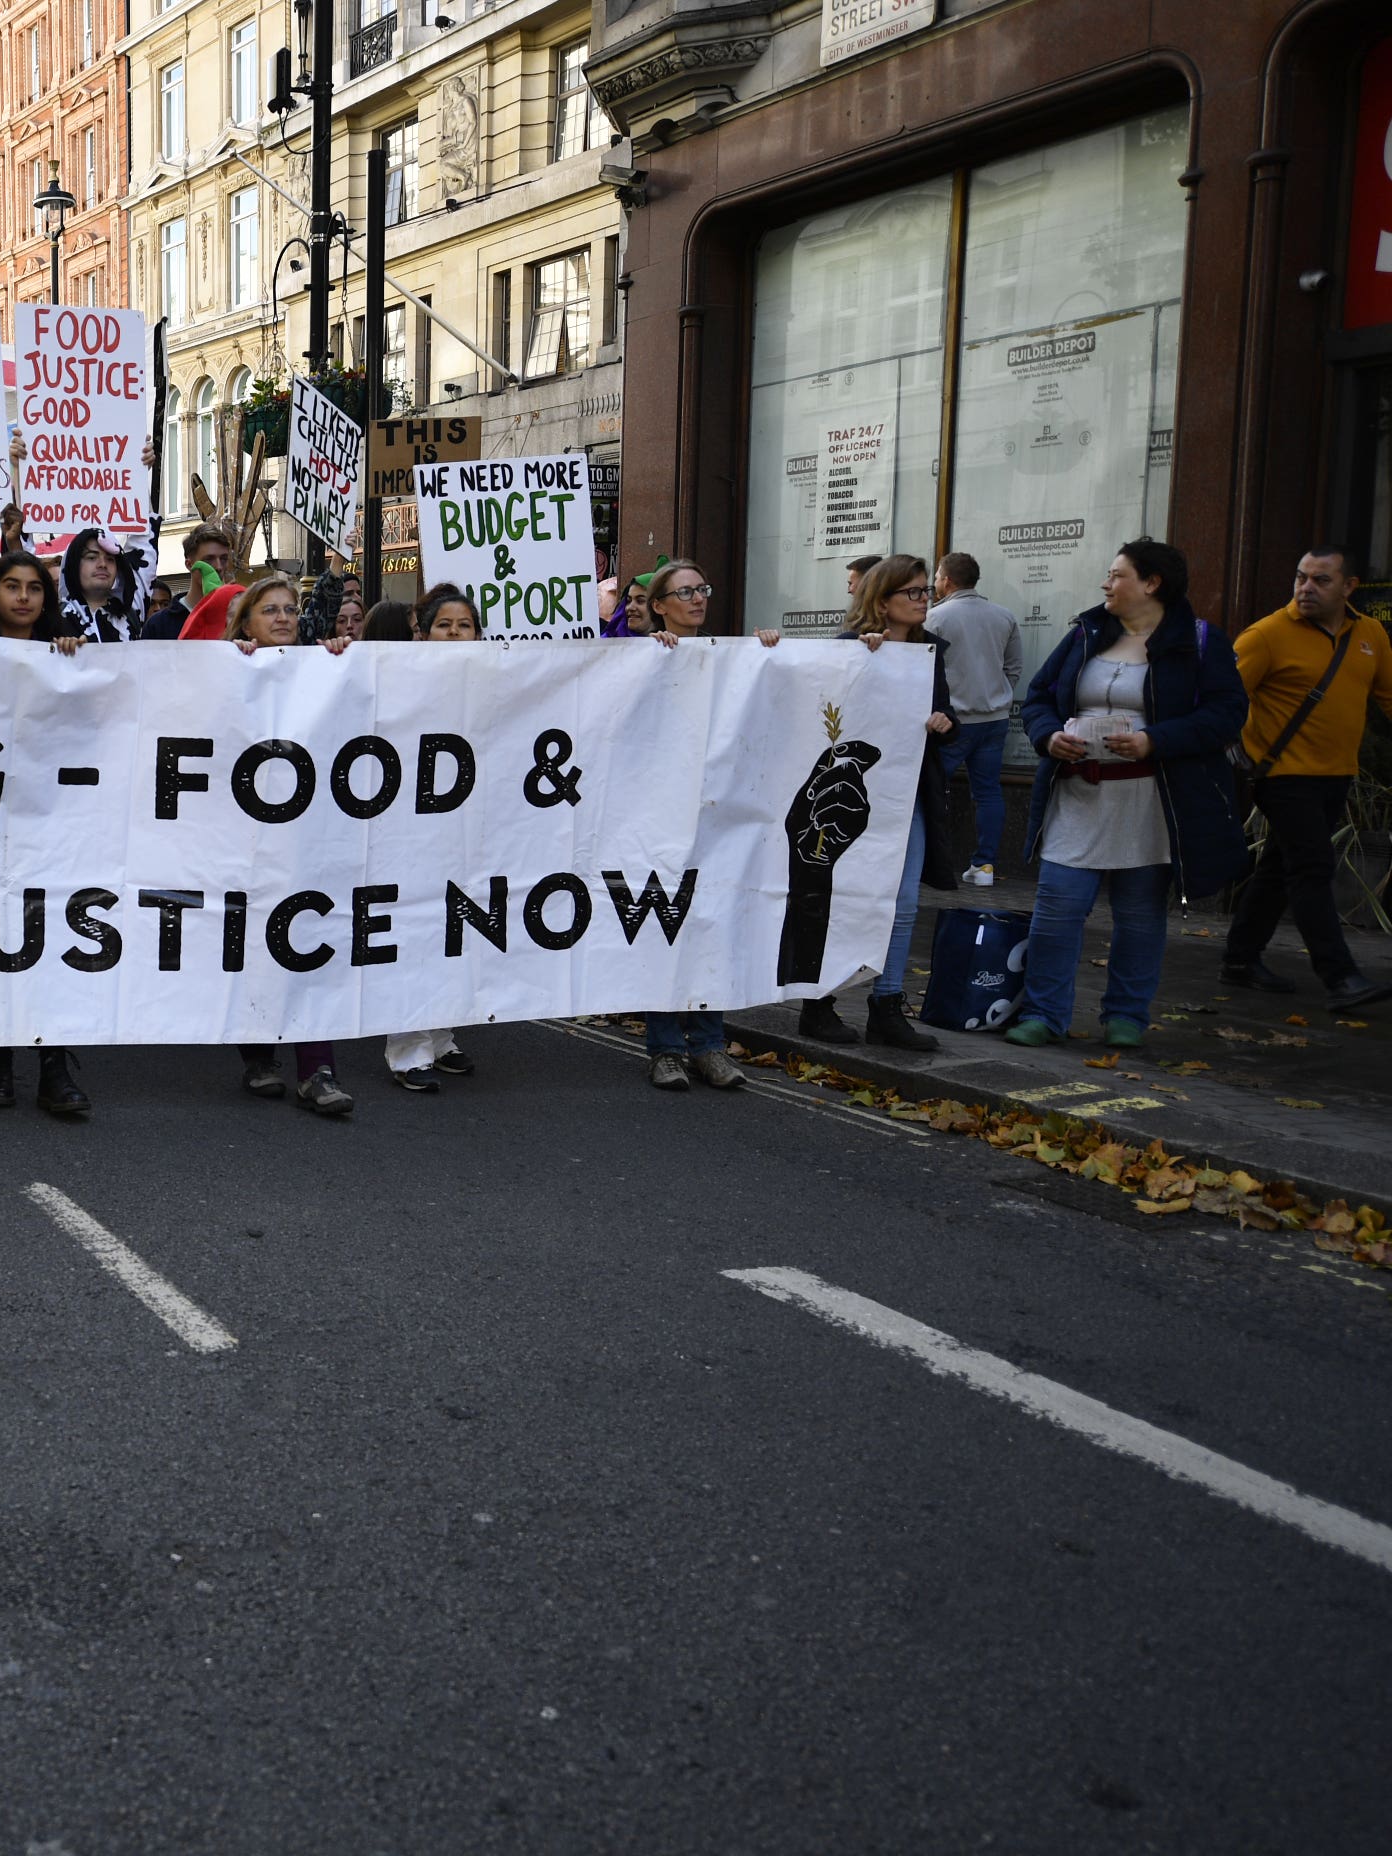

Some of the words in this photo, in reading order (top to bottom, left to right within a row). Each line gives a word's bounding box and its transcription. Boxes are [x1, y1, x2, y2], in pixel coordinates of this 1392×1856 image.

[831, 0, 883, 36] STREET
[829, 48, 844, 60] CITY
[846, 42, 856, 53] OF
[857, 20, 909, 49] WESTMINSTER
[34, 308, 120, 355] FOOD
[1009, 345, 1052, 363] BUILDER
[1056, 336, 1094, 354] DEPOT
[23, 350, 144, 400] JUSTICE:
[1012, 354, 1090, 375] www.builderdepot.co.uk
[294, 379, 309, 415] I
[23, 394, 91, 428] GOOD
[377, 418, 467, 446] THIS
[828, 428, 856, 442] TRAF
[858, 424, 884, 438] 24/7
[32, 434, 129, 463] QUALITY
[297, 415, 359, 483] CHILLIES
[415, 444, 438, 464] IS
[828, 445, 844, 453] OFF
[846, 439, 881, 451] LICENCE
[833, 455, 852, 464] NOW
[853, 452, 876, 461] OPEN
[24, 465, 131, 491] AFFORDABLE
[308, 448, 341, 488] HOT
[590, 468, 603, 482] TO
[788, 458, 816, 472] BUILDE
[829, 467, 852, 476] ALCOHOL
[292, 455, 323, 498] NOT
[328, 489, 350, 523] MY
[420, 466, 450, 498] WE
[460, 463, 513, 492] NEED
[524, 461, 583, 490] MORE
[828, 478, 857, 488] GROCERIES
[827, 501, 858, 511] HOUSEHOLD
[859, 499, 877, 508] GOODS
[828, 490, 853, 499] TOBACCO
[23, 503, 65, 524] FOOD
[72, 504, 101, 525] FOR
[107, 496, 148, 524] ALL
[293, 487, 346, 549] PLANET
[439, 490, 575, 551] BUDGET
[827, 513, 856, 523] ELECTRICAL
[857, 512, 873, 520] ITEMS
[825, 538, 840, 546] CASH
[826, 526, 844, 534] PHONE
[845, 523, 880, 532] ACCESSORIES
[1000, 526, 1043, 541] BUILDER
[1047, 523, 1083, 537] DEPOT
[1003, 540, 1078, 553] www.builderdepot.co.uk
[494, 544, 516, 580] &
[466, 575, 592, 629] PPORT
[784, 614, 815, 626] BUILDER
[817, 613, 846, 624] DEPOT
[156, 734, 475, 823] FOOD
[524, 729, 582, 808] &
[445, 869, 698, 957] NOW
